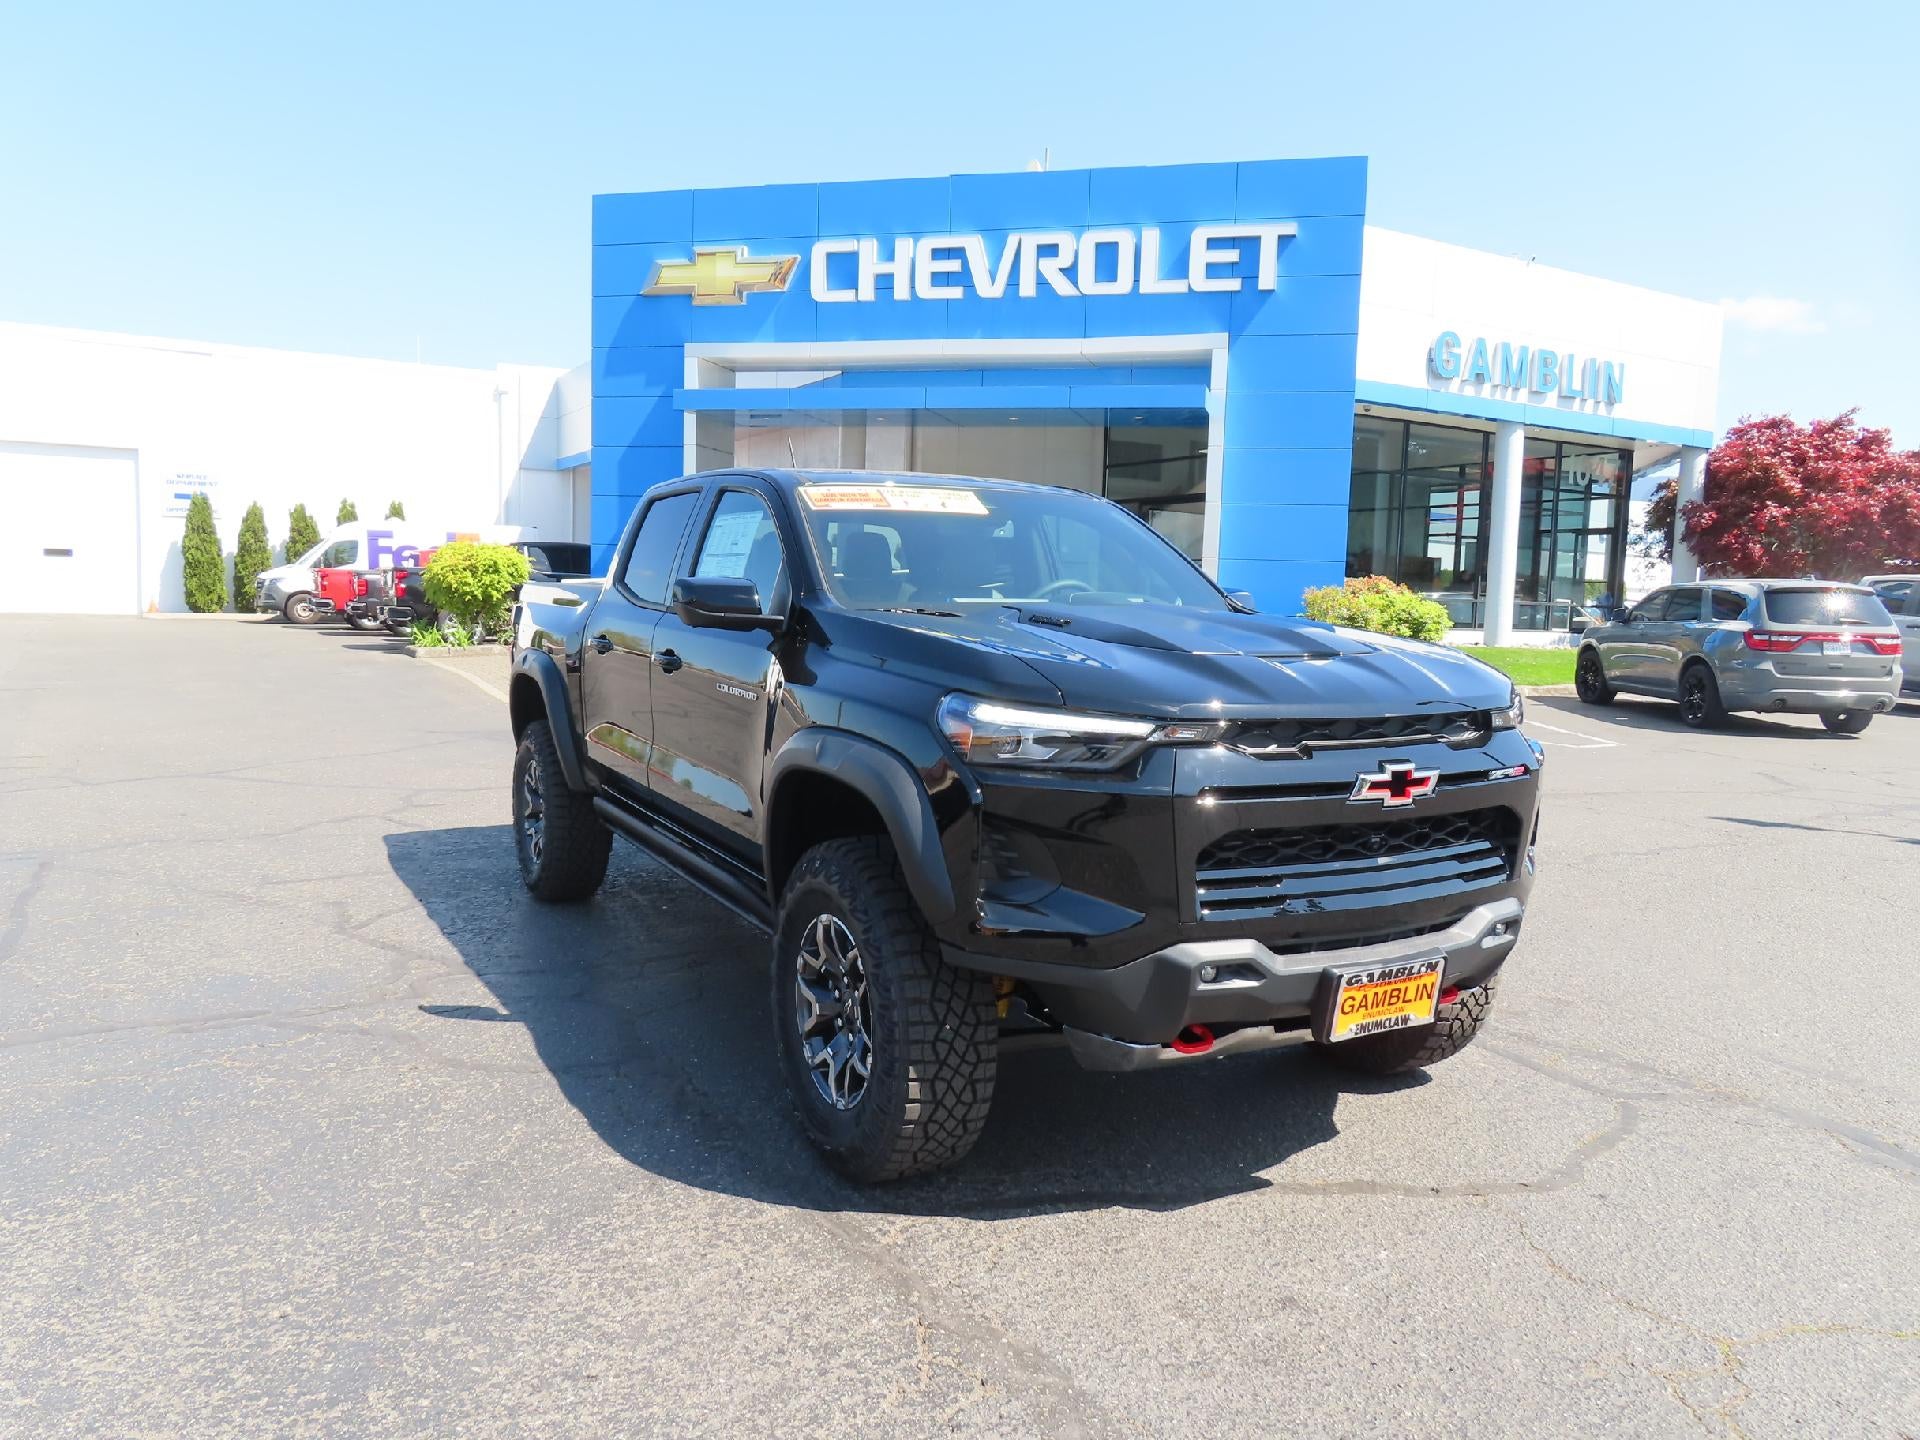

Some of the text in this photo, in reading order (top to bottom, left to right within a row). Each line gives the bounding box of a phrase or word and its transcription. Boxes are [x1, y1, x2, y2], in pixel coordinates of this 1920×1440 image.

[810, 222, 1298, 303] CHEVROLET
[1429, 331, 1625, 404] GAMBLIN
[716, 683, 757, 701] COLORADO
[1346, 961, 1441, 987] GAMBLIN
[1341, 982, 1435, 1015] GAMBLIN
[1355, 1014, 1411, 1035] ENUMCLAW
[1362, 1005, 1406, 1019] ENUMCLAW
